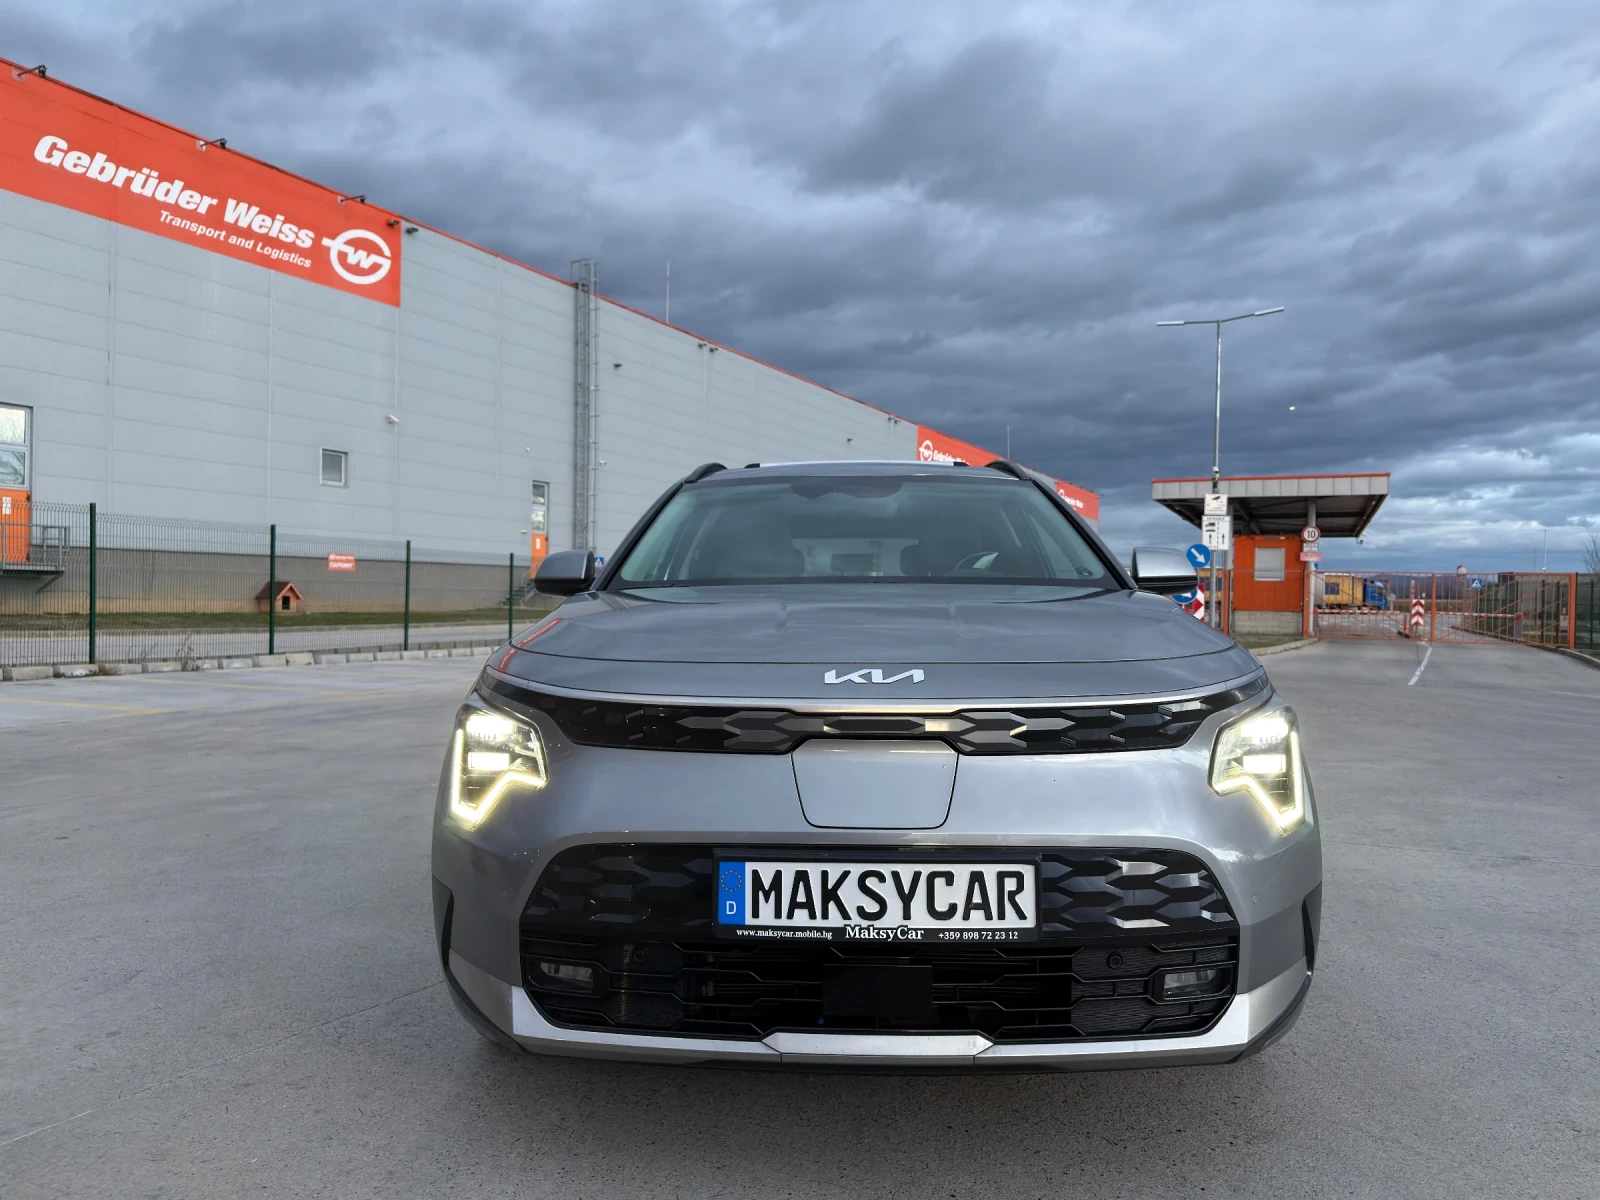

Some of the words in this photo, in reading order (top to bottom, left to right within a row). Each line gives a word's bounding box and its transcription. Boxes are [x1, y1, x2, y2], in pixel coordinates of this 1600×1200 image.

[34, 135, 218, 216] Gebrüder
[224, 197, 315, 248] Weiss
[159, 210, 226, 242] Transport
[228, 234, 254, 250] and
[257, 241, 312, 269] Logistics
[1307, 530, 1316, 538] 10
[751, 869, 1028, 921] MAKSYCAR
[725, 901, 737, 915] D
[736, 928, 832, 940] www.maksycar.mobile.bg
[845, 926, 924, 941] MaksyCar
[938, 931, 960, 940] +359
[962, 931, 979, 940] 898
[981, 931, 993, 940] 72
[994, 931, 1006, 940] 23
[1008, 931, 1018, 940] 12
